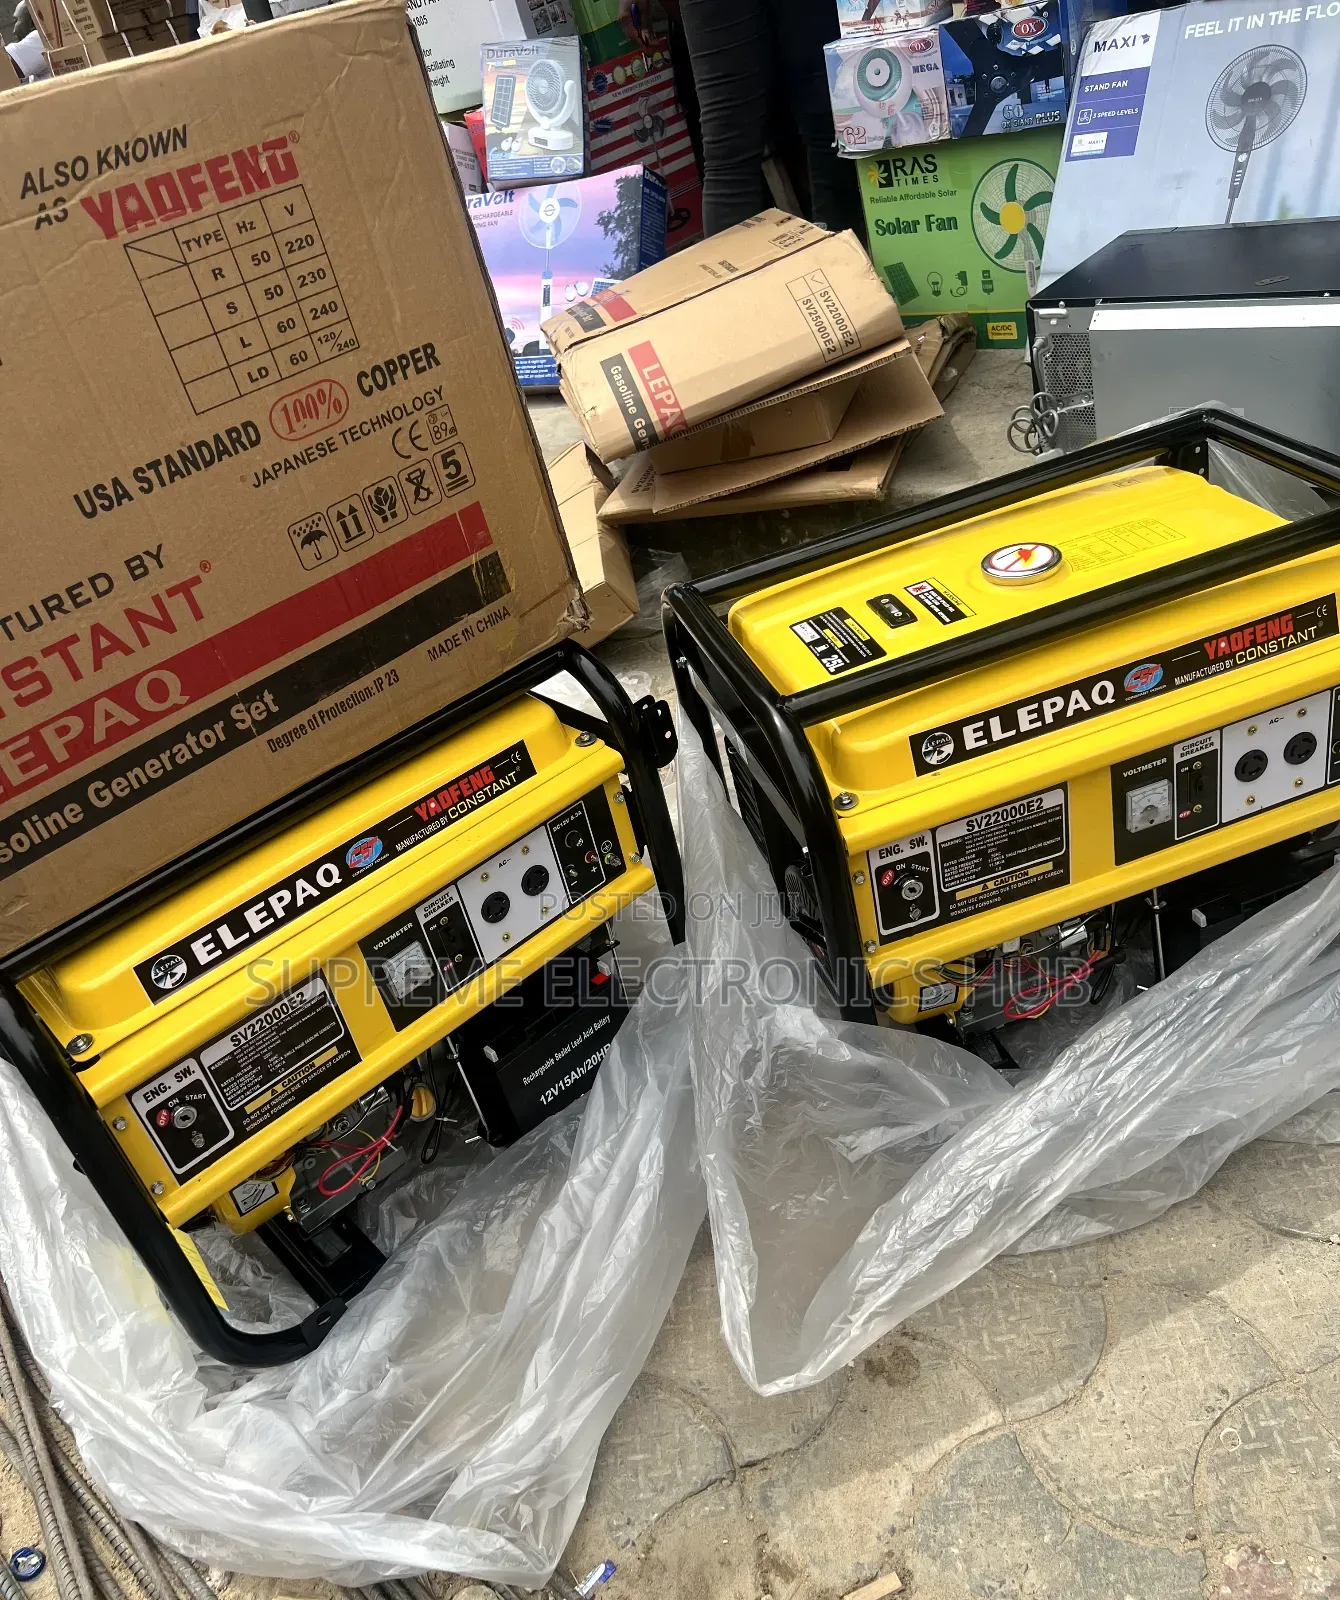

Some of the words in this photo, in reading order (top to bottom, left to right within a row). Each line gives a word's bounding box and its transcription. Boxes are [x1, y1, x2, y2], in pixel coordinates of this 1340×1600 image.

[1184, 20, 1224, 40] FEEL
[1227, 16, 1244, 33] IT
[1246, 13, 1265, 30] IN
[1268, 7, 1302, 26] THE
[486, 45, 540, 59] DuraVolt
[1094, 35, 1136, 53] MAXI
[912, 63, 939, 74] MEGA
[1085, 83, 1110, 93] STAND
[1112, 80, 1128, 89] FAN
[1013, 117, 1033, 127] GIANT
[1035, 111, 1060, 124] PLUS
[1097, 110, 1116, 118] SPEED
[1117, 108, 1139, 116] LEVELS
[843, 126, 866, 145] 62
[20, 155, 89, 200] ALSO
[96, 124, 188, 175] KNOWN
[892, 154, 938, 176] RAS
[869, 195, 898, 204] Reliable
[899, 190, 936, 202] Affordable
[937, 189, 957, 198] Solar
[897, 175, 939, 187] TIMES
[34, 197, 69, 230] AS
[467, 190, 515, 209] raVolt
[182, 230, 224, 252] TYPE
[237, 220, 257, 234] Hz
[284, 203, 295, 217] V
[874, 217, 920, 237] Solar
[925, 214, 959, 232] Fan
[211, 267, 226, 281] R
[251, 250, 271, 266] 50
[284, 234, 315, 254] 220
[226, 302, 239, 315] S
[264, 284, 284, 301] 50
[297, 268, 327, 288] 230
[240, 336, 252, 349] L
[276, 317, 297, 335] 60
[309, 300, 339, 323] 240
[802, 298, 837, 355] SV25000E2
[820, 290, 854, 347] SV22000E2
[247, 365, 270, 384] LD
[289, 350, 308, 366] 60
[611, 365, 637, 415] Gasoline
[73, 476, 134, 520] USA
[132, 419, 262, 495] STANDARD
[280, 383, 343, 436] 100%
[356, 342, 441, 397] COPPER
[251, 436, 339, 489] JAPANESE
[338, 385, 446, 447] TECHNOLOGY
[0, 572, 115, 641] TURED
[124, 543, 164, 582] BY
[0, 575, 205, 722] STANT
[427, 633, 462, 662] MADE
[460, 627, 475, 643] IN
[475, 606, 512, 633] CHINA
[1204, 613, 1294, 660] YAOFENG
[1174, 661, 1225, 685] MANUFACTURED
[1225, 659, 1234, 669] BY
[1236, 625, 1317, 664] CONSTANT
[267, 720, 308, 753] Degree
[306, 711, 320, 731] of
[318, 685, 375, 726] Protection:
[373, 676, 386, 694] IP
[384, 669, 400, 685] 23
[962, 680, 1116, 750] ELEPAQ
[0, 669, 190, 795] EPAQ
[87, 721, 226, 808] Generator
[230, 689, 280, 730] Set
[1182, 736, 1212, 752] CIRCUIT
[1180, 742, 1215, 758] BREAKER
[1123, 757, 1167, 778] VOLTMETER
[414, 765, 495, 822] YAOFENG
[395, 820, 440, 852] MANUFACTURED
[440, 815, 449, 826] BY
[448, 771, 517, 819] CONSTANT
[965, 796, 1043, 833] SV22000E2
[1179, 810, 1191, 818] OFF
[878, 846, 904, 860] ENG.
[909, 835, 928, 850] SW.
[882, 870, 893, 886] OFF
[895, 863, 906, 871] ON
[911, 863, 930, 873] START
[993, 870, 1028, 887] CAUTION
[190, 862, 343, 966] ELEPAQ
[423, 892, 450, 913] CIRCUIT
[423, 896, 454, 919] BREAKER
[373, 922, 413, 951] VOLTMETER
[228, 990, 307, 1048] SV22000E2
[522, 1057, 555, 1086] Rechargeable
[554, 1044, 571, 1061] Sealed
[571, 1035, 583, 1049] Lead
[582, 1026, 594, 1040] Acid
[593, 1015, 611, 1031] Battery
[143, 1082, 172, 1104] ENG.
[174, 1065, 196, 1084] SW.
[242, 1116, 251, 1125] DO
[249, 1110, 260, 1120] NOT
[260, 1103, 271, 1113] USE
[270, 1089, 291, 1106] INDOORS
[290, 1082, 301, 1092] DUE
[307, 1065, 326, 1081] DANGER
[332, 1048, 351, 1064] CARBON
[281, 1061, 315, 1088] CAUTION
[168, 1097, 179, 1108] ON
[185, 1093, 207, 1101] START
[245, 1112, 270, 1132] MONOXIDE
[270, 1095, 295, 1114] POISONING
[159, 1110, 168, 1127] OFF
